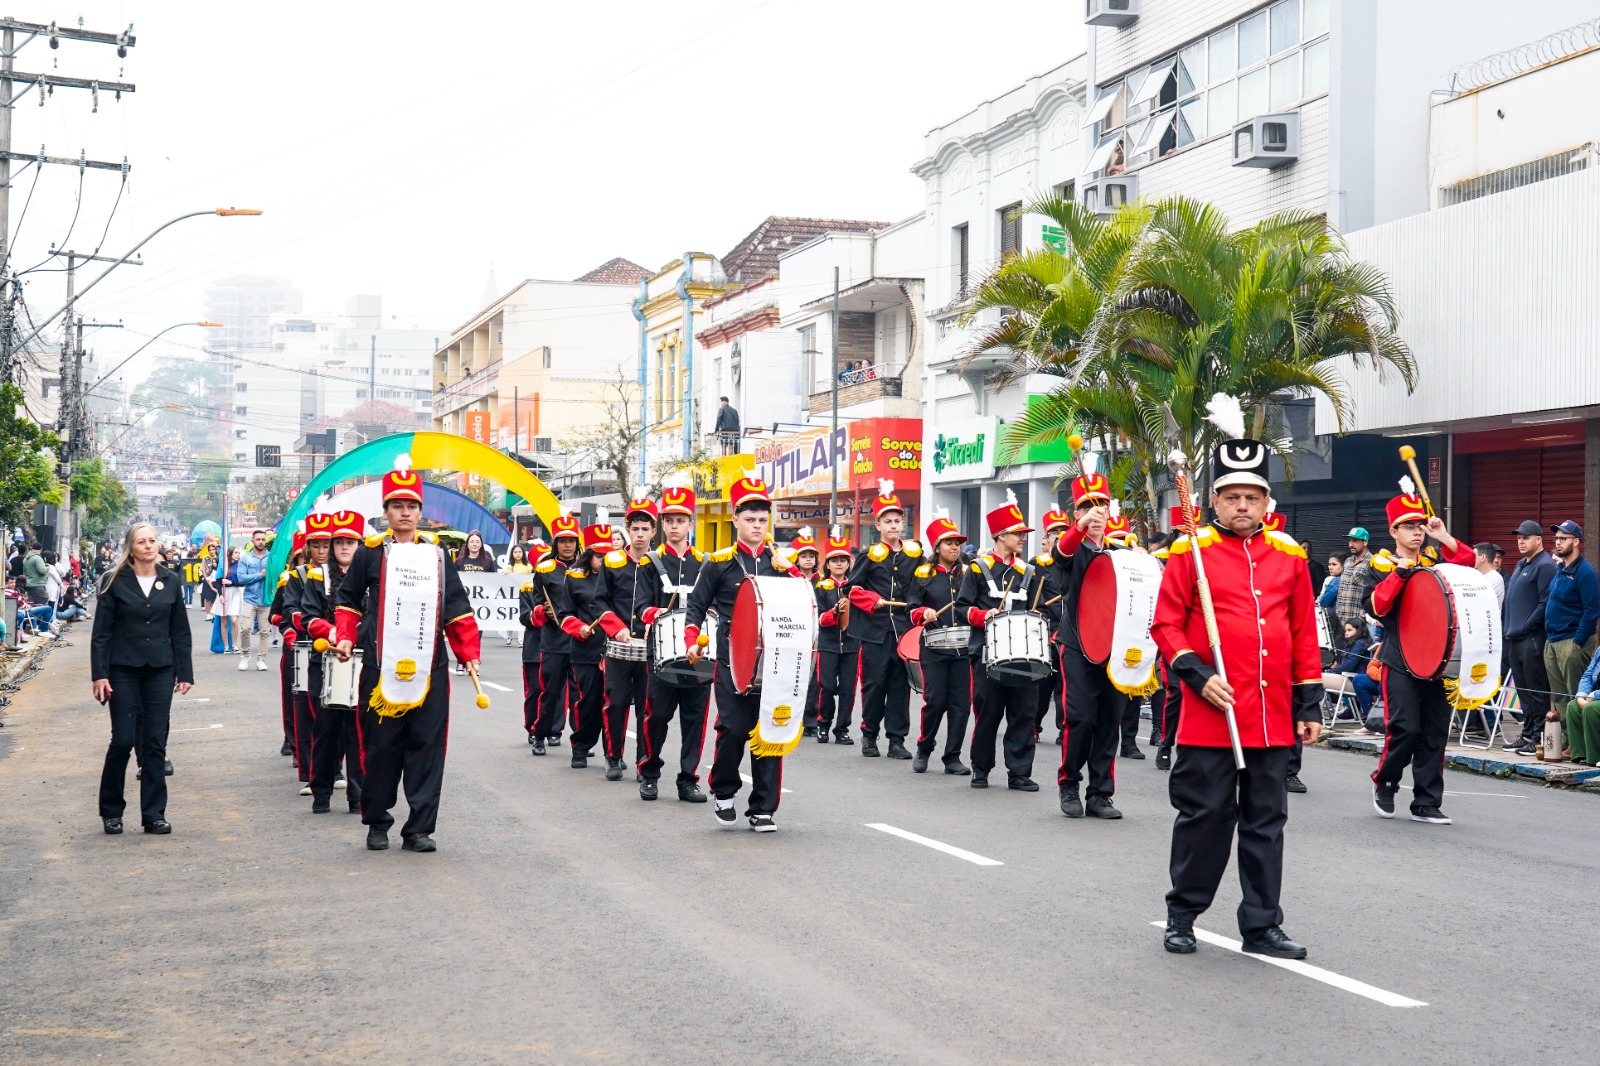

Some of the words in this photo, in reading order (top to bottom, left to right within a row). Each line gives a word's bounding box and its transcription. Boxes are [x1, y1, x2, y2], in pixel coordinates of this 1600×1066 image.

[471, 415, 485, 442] péia
[851, 435, 871, 453] Sorvete
[898, 450, 913, 460] do
[946, 433, 985, 467] Sicredi
[761, 426, 847, 496] UTILAR
[395, 566, 417, 574] BANDA
[403, 573, 431, 581] MARCIAL
[472, 605, 491, 621] O
[418, 602, 426, 650] HOLDERBAUM
[793, 652, 802, 697] HOLDERBAUM
